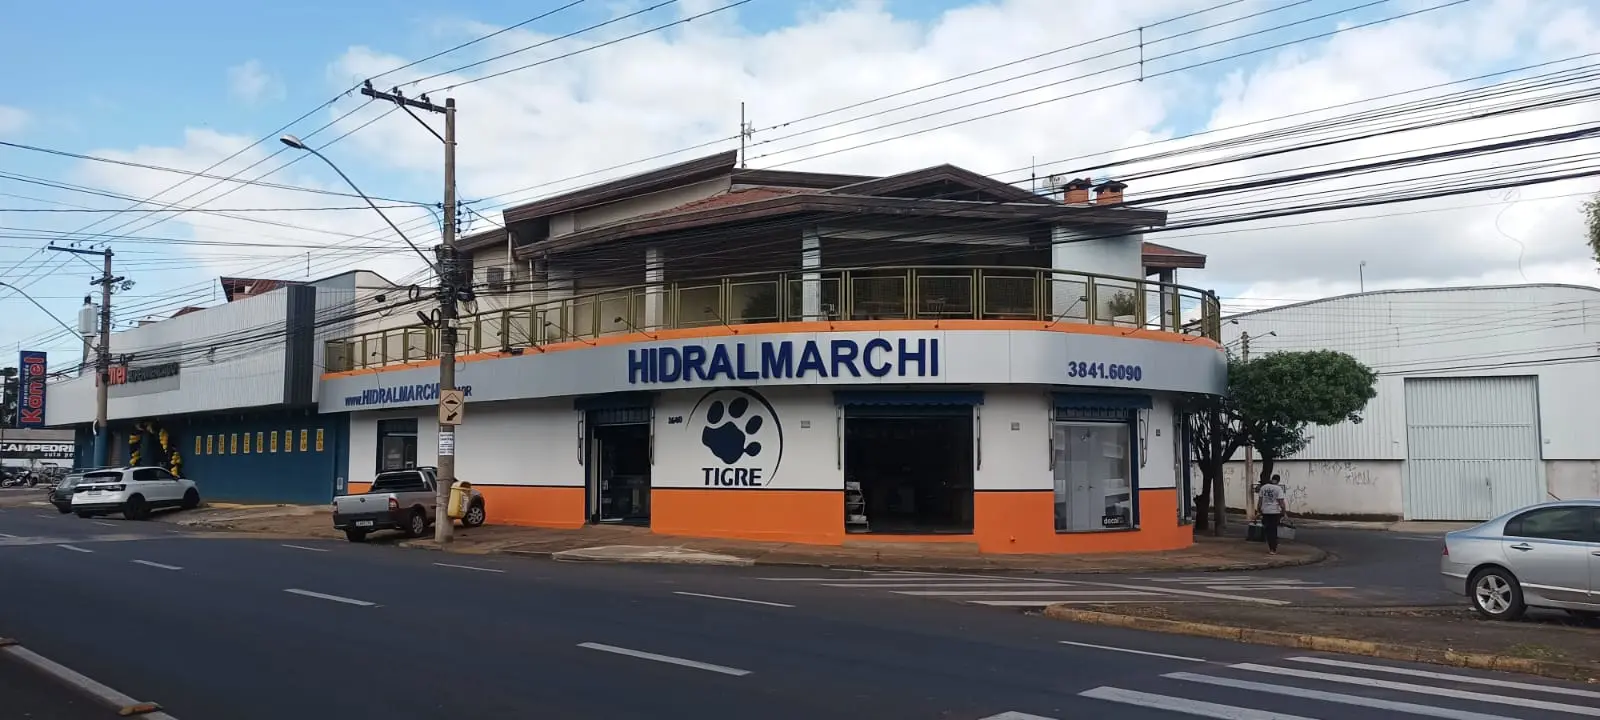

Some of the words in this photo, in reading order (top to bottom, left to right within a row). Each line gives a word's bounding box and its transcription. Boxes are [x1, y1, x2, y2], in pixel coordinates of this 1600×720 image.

[628, 338, 938, 384] HIDRALMARCHI
[1068, 361, 1142, 381] 3841.6090
[21, 357, 44, 422] Kamel
[702, 467, 762, 486] TIGRE
